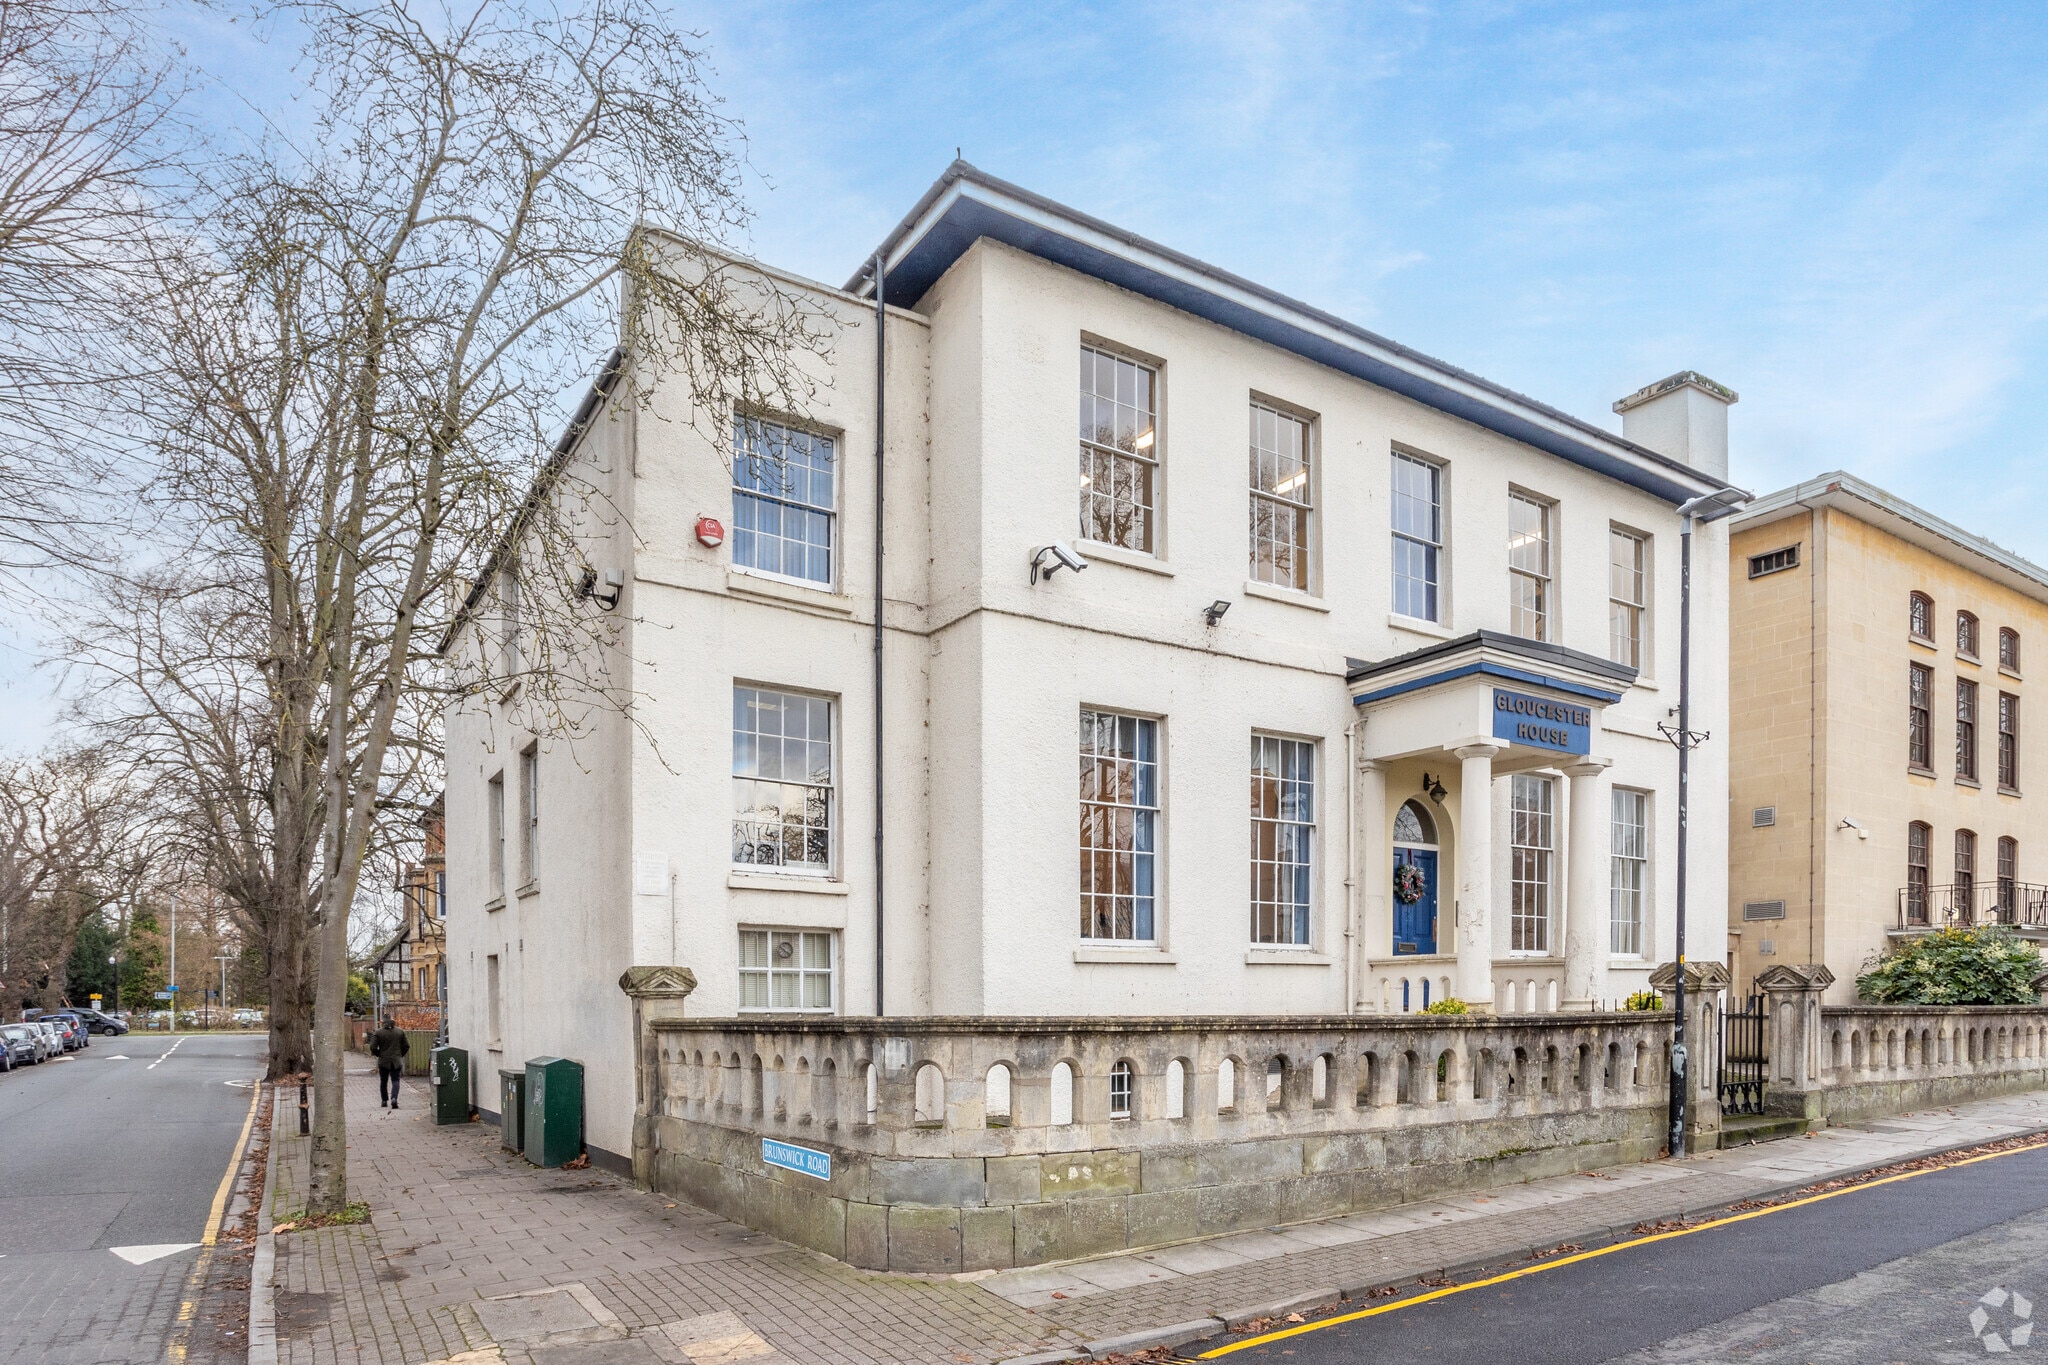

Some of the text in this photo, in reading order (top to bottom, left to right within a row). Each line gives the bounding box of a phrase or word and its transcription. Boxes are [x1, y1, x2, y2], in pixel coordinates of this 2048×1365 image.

[1496, 694, 1590, 727] GLOUCESTER
[1517, 722, 1568, 746] HOUSE
[764, 1143, 828, 1174] BRUNSWICK ROAD
